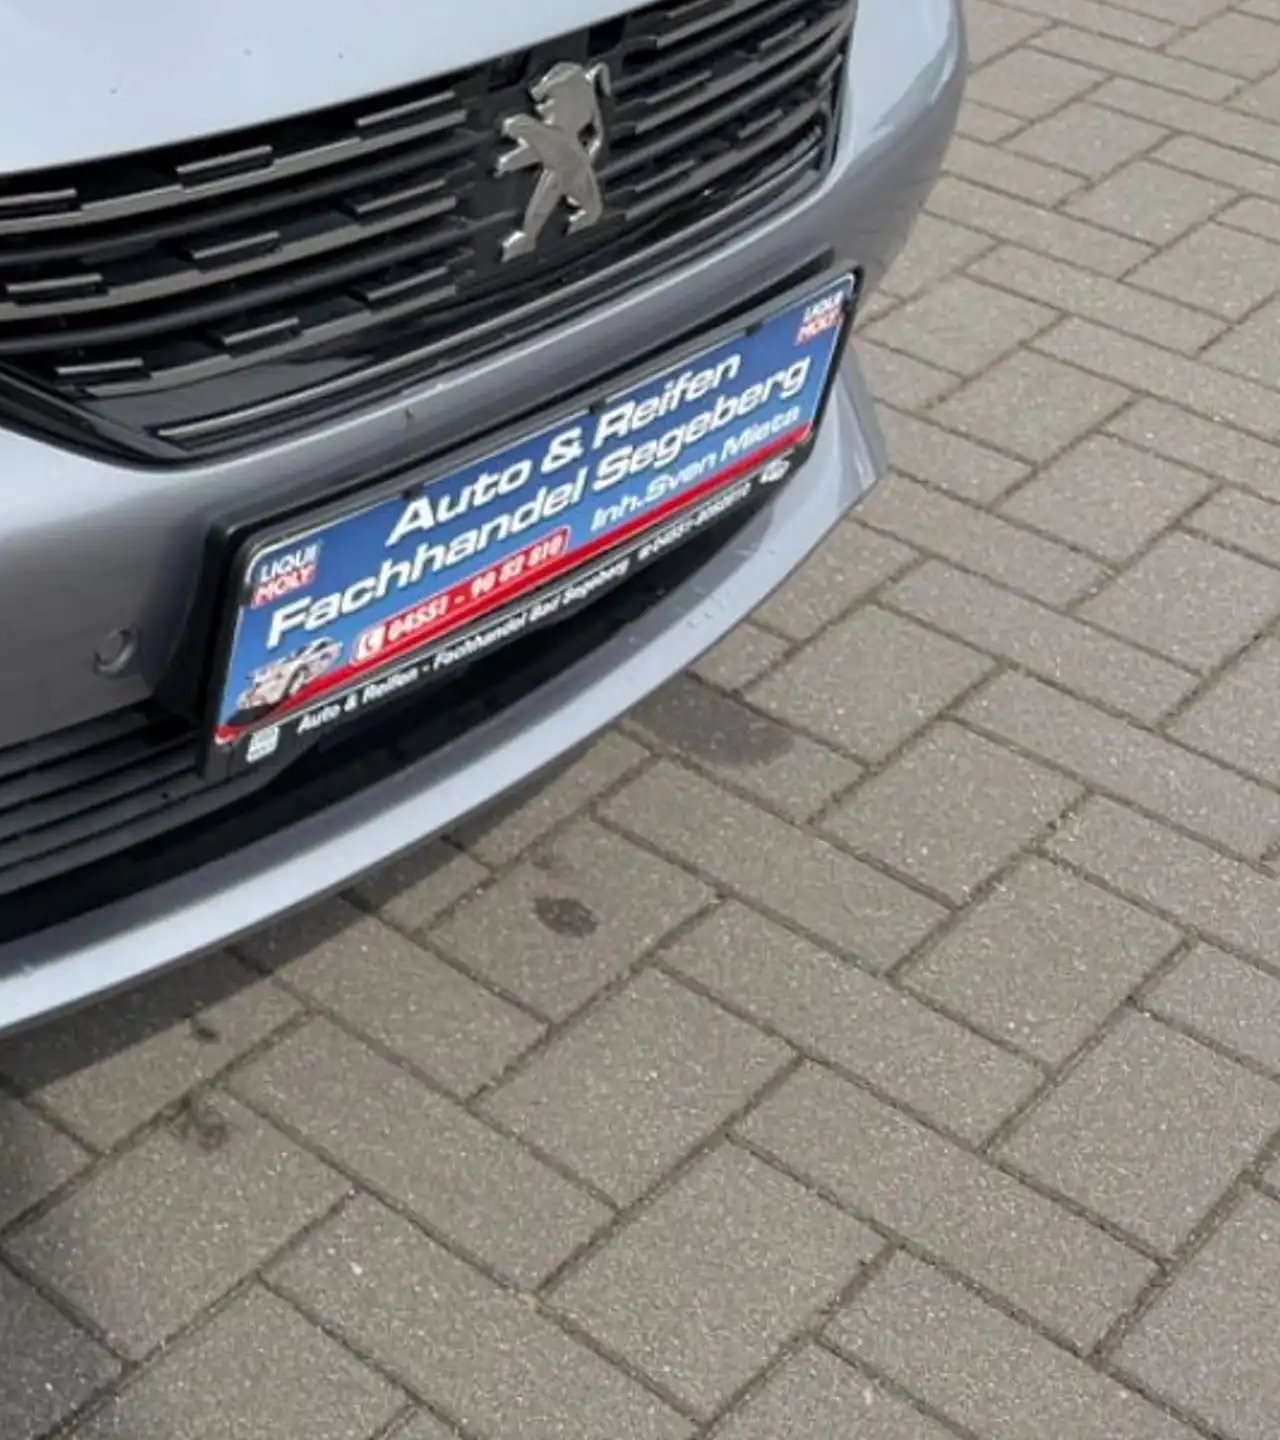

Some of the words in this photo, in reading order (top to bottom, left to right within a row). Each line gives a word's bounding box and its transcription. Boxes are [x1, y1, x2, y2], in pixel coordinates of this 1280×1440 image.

[385, 458, 532, 547] Auto
[541, 426, 584, 474] &
[592, 355, 741, 450] Reifen
[266, 466, 588, 649] Fachhandel
[592, 356, 810, 491] Segeberg
[259, 543, 319, 583] LIQUI
[251, 564, 316, 608] MOLY
[297, 702, 341, 733] Auto
